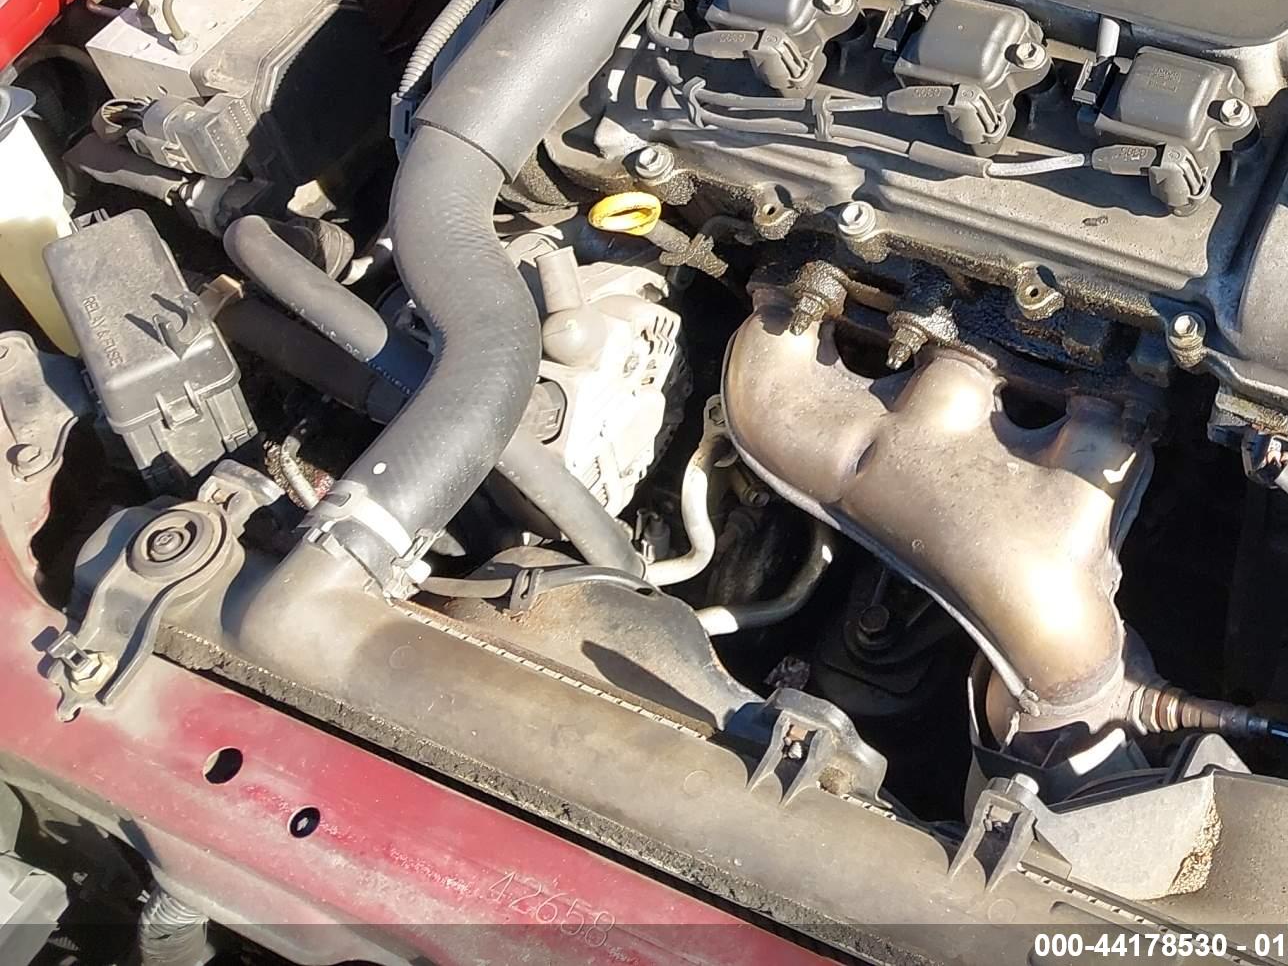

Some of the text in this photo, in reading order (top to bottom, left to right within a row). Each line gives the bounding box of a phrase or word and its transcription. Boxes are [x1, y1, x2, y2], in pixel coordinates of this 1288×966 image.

[82, 295, 125, 369] RELAY & FUSE
